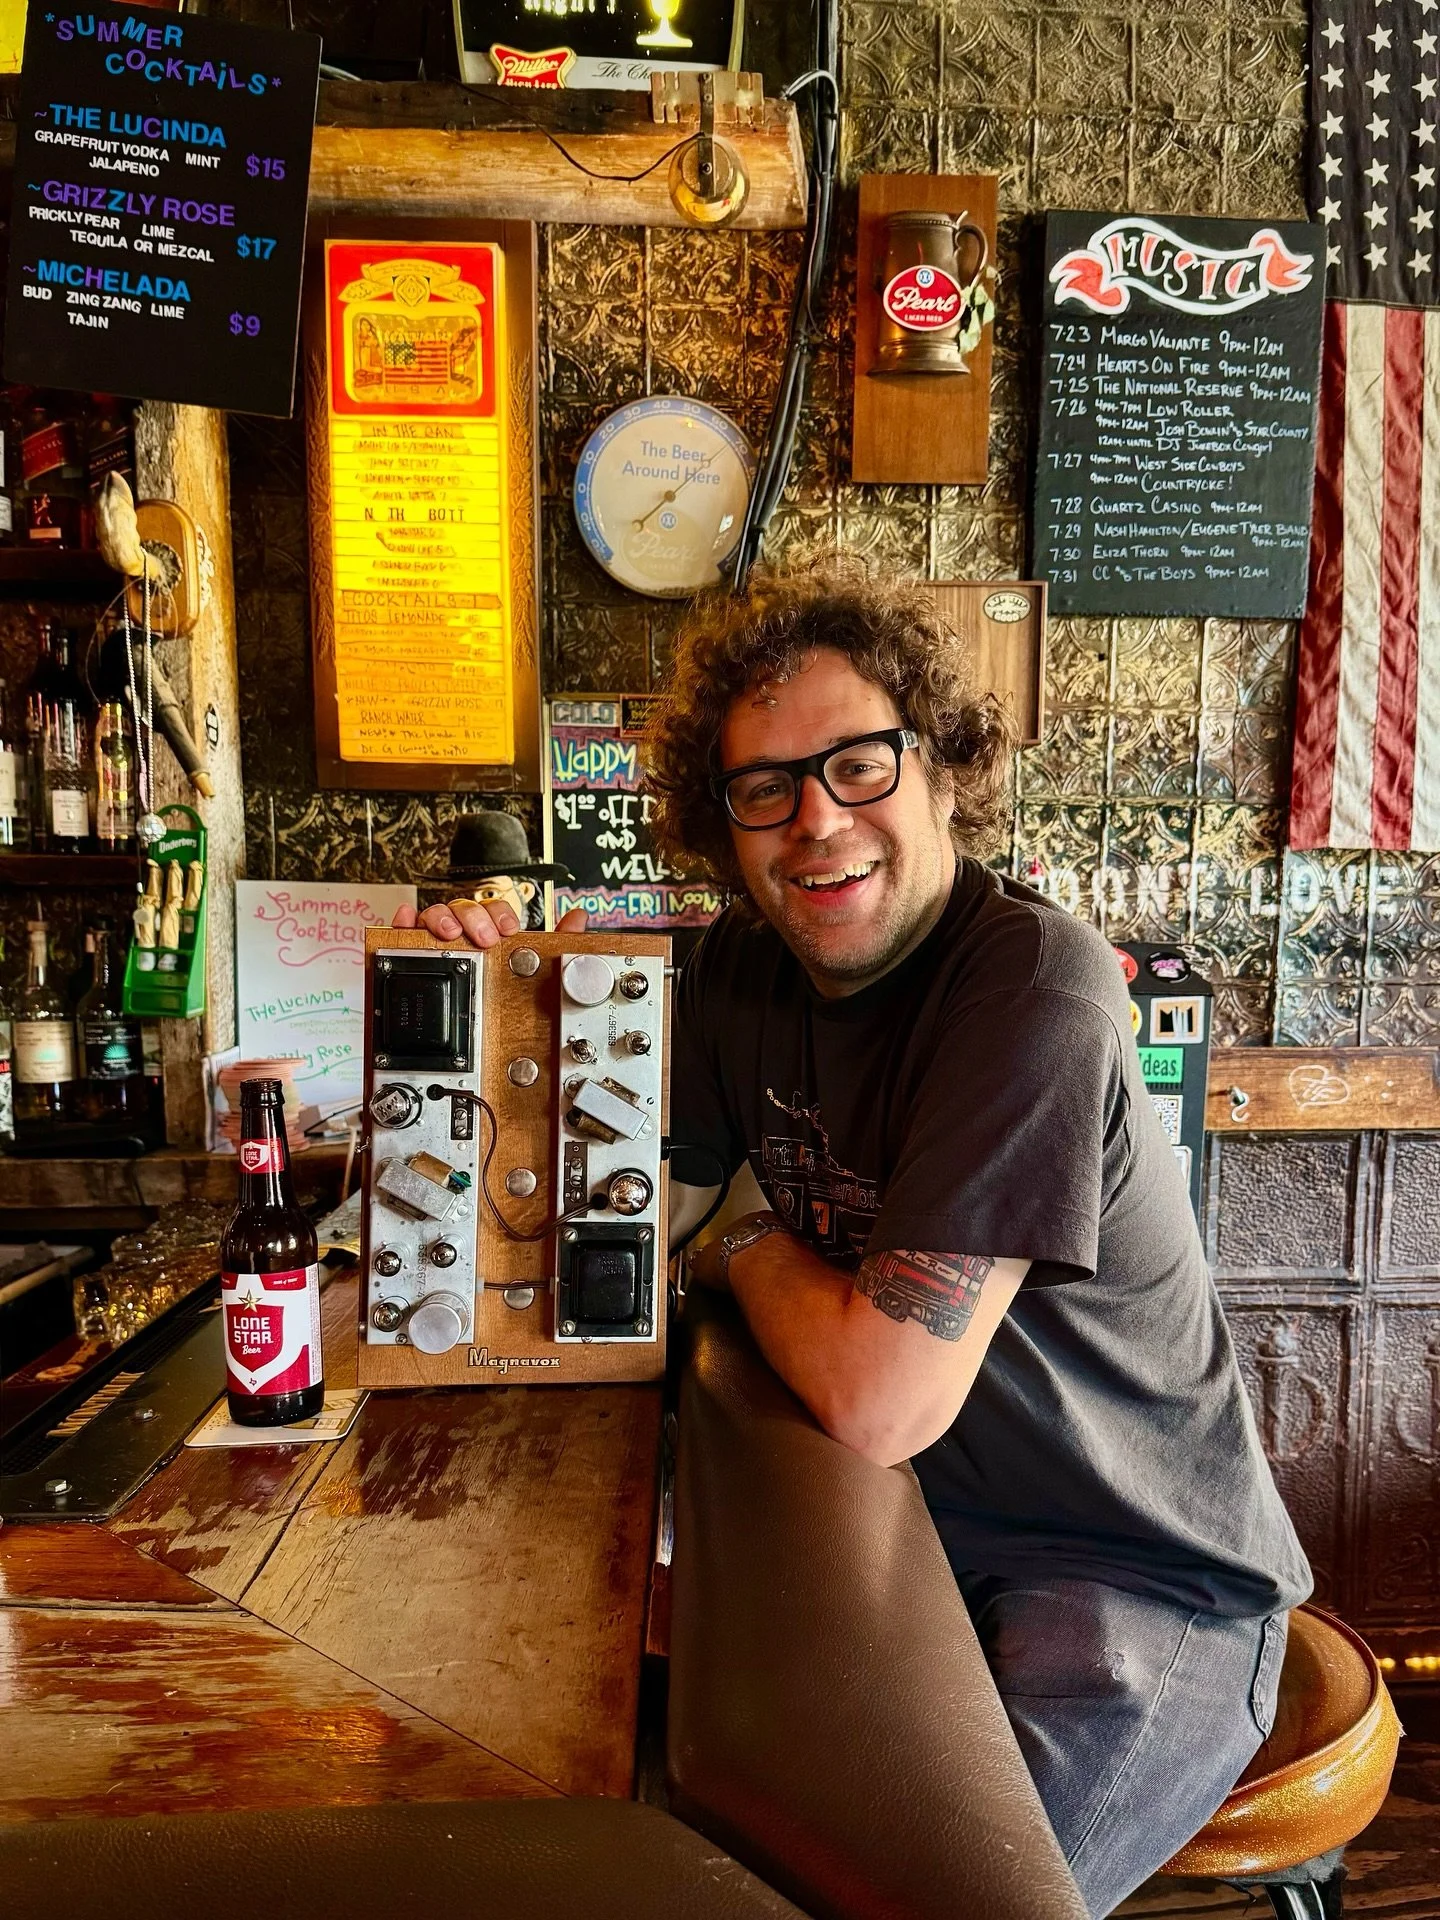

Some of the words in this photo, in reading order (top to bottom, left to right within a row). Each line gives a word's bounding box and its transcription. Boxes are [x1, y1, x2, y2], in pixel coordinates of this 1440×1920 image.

[57, 15, 184, 50] SUMMER
[503, 56, 559, 76] Miller
[591, 61, 622, 79] The
[49, 104, 101, 130] THE
[109, 111, 227, 148] LUCINDA
[35, 130, 119, 153] GRAPEFRUIT
[121, 142, 171, 162] VODKA
[185, 152, 220, 169] MINT
[89, 156, 160, 177] JALAPENO
[246, 153, 285, 180] $15
[43, 180, 156, 216] GRIZZLY
[163, 197, 235, 227] ROSE
[29, 205, 83, 224] PRICKLY
[84, 213, 121, 230] PEAR
[142, 223, 175, 240] LIME
[70, 229, 128, 249] TEQUILA
[133, 239, 154, 254] OR
[158, 242, 215, 262] MEZCAL
[237, 233, 277, 260] $17
[1102, 231, 1259, 301] MUSIC
[37, 259, 191, 302] MICHELADA
[22, 285, 53, 300] BUD
[66, 291, 100, 307] ZING
[102, 296, 142, 314] ZANG
[150, 303, 185, 320] LIME
[892, 286, 957, 313] Pearl
[67, 311, 109, 329] TAJIN
[229, 310, 261, 337] $9
[1101, 326, 1147, 346] MARGO
[1149, 328, 1210, 351] VALIANTE
[1097, 353, 1149, 374] HEARTS
[1151, 356, 1173, 374] ON
[1179, 356, 1210, 375] FIRE
[1092, 375, 1120, 395] THE
[1125, 377, 1182, 396] NATIONAL
[1184, 378, 1244, 397] RESERVE
[624, 406, 641, 421] 30
[653, 400, 671, 409] 40
[682, 403, 701, 414] 50
[1147, 399, 1178, 417] LOW
[1180, 400, 1234, 417] ROLLER
[372, 425, 387, 437] IN
[393, 423, 417, 437] THE
[599, 423, 615, 440] 20
[1154, 419, 1185, 436] JOSH
[1244, 421, 1271, 437] STAR
[641, 441, 667, 458] The
[672, 444, 706, 462] Beer
[1155, 437, 1182, 452] DJ
[583, 451, 596, 465] 10
[1135, 455, 1167, 471] WEST
[1171, 457, 1197, 472] SIDE
[1198, 456, 1245, 472] COWBOYS
[622, 460, 680, 481] Around
[685, 467, 721, 485] Here
[1090, 496, 1146, 514] QUARTZ
[1151, 495, 1202, 514] CASINO
[1094, 522, 1127, 537] NASH
[1238, 521, 1273, 536] TYLER
[1276, 523, 1308, 536] BAND
[1093, 544, 1128, 559] ELIZA
[1130, 544, 1169, 558] THORN
[1092, 565, 1111, 580] CC
[1132, 567, 1157, 581] THE
[1157, 566, 1196, 581] BOYS
[389, 611, 446, 625] LEMONADE
[361, 712, 392, 724] RANCH
[1250, 864, 1401, 916] LOVE
[254, 891, 375, 921] Summer
[234, 1316, 270, 1330] LONE
[234, 1331, 274, 1344] STAR
[242, 1345, 262, 1355] Beer
[468, 1347, 560, 1375] Magnavox
